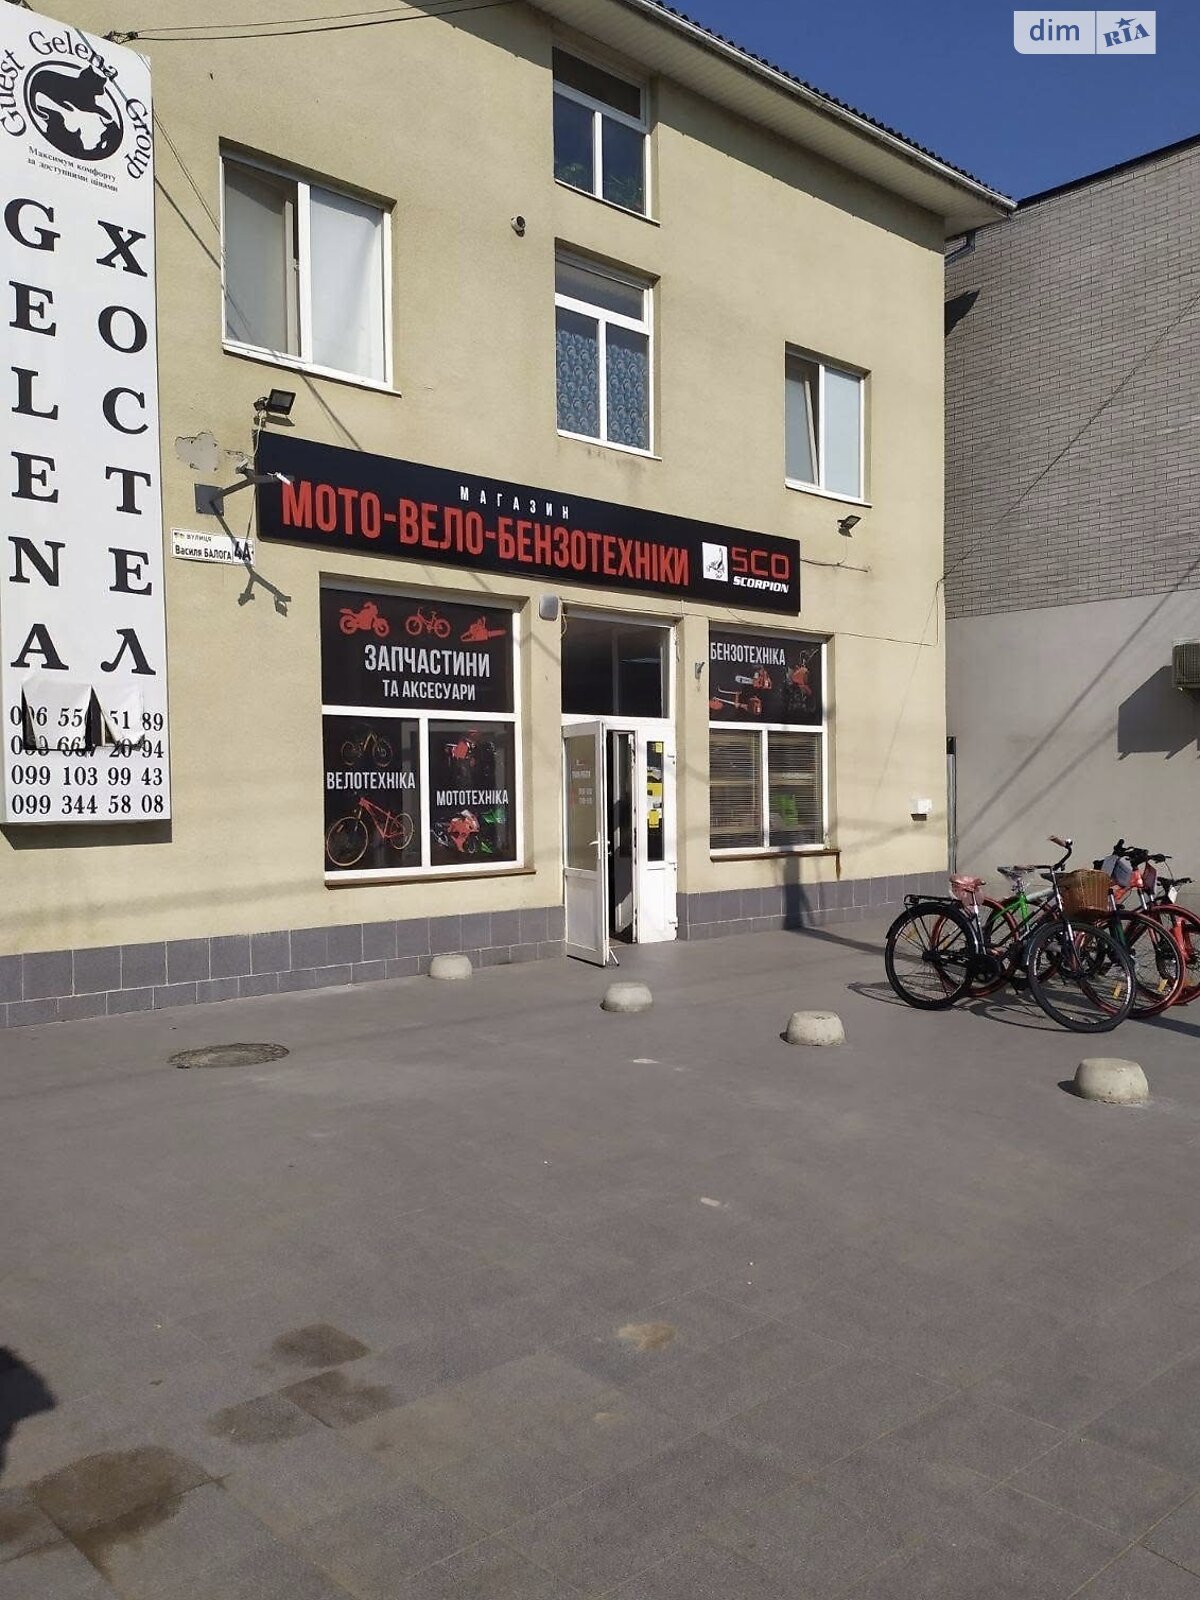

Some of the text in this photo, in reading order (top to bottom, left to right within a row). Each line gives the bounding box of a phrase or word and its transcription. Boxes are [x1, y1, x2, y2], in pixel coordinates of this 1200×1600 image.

[0, 31, 152, 180] Guest Gelena Group
[28, 157, 36, 166] за
[28, 145, 118, 183] Максимум комфорту
[460, 486, 569, 520] МАГАЗИН
[187, 533, 212, 543] вулиця
[281, 480, 691, 587] МОТО-ВЕЛО-БЕНЗОТЕХНІКИ
[175, 544, 232, 560] Василя БАЛОГА
[731, 546, 790, 580] SCO
[732, 575, 790, 594] SCORPION
[364, 644, 491, 677] ЗАПЧАСТИНИ
[710, 642, 786, 666] БЕНЗОТЕХНІКА
[382, 679, 476, 701] ТА АКСЕСУАРИ
[141, 712, 164, 732] 89
[141, 739, 164, 759] 94
[11, 765, 164, 786] 099 103 99 43
[326, 771, 416, 790] ВЕЛОТЕХНІКА
[11, 794, 164, 815] 099 344 58 08
[436, 789, 509, 807] МОТОТЕХНІКА
